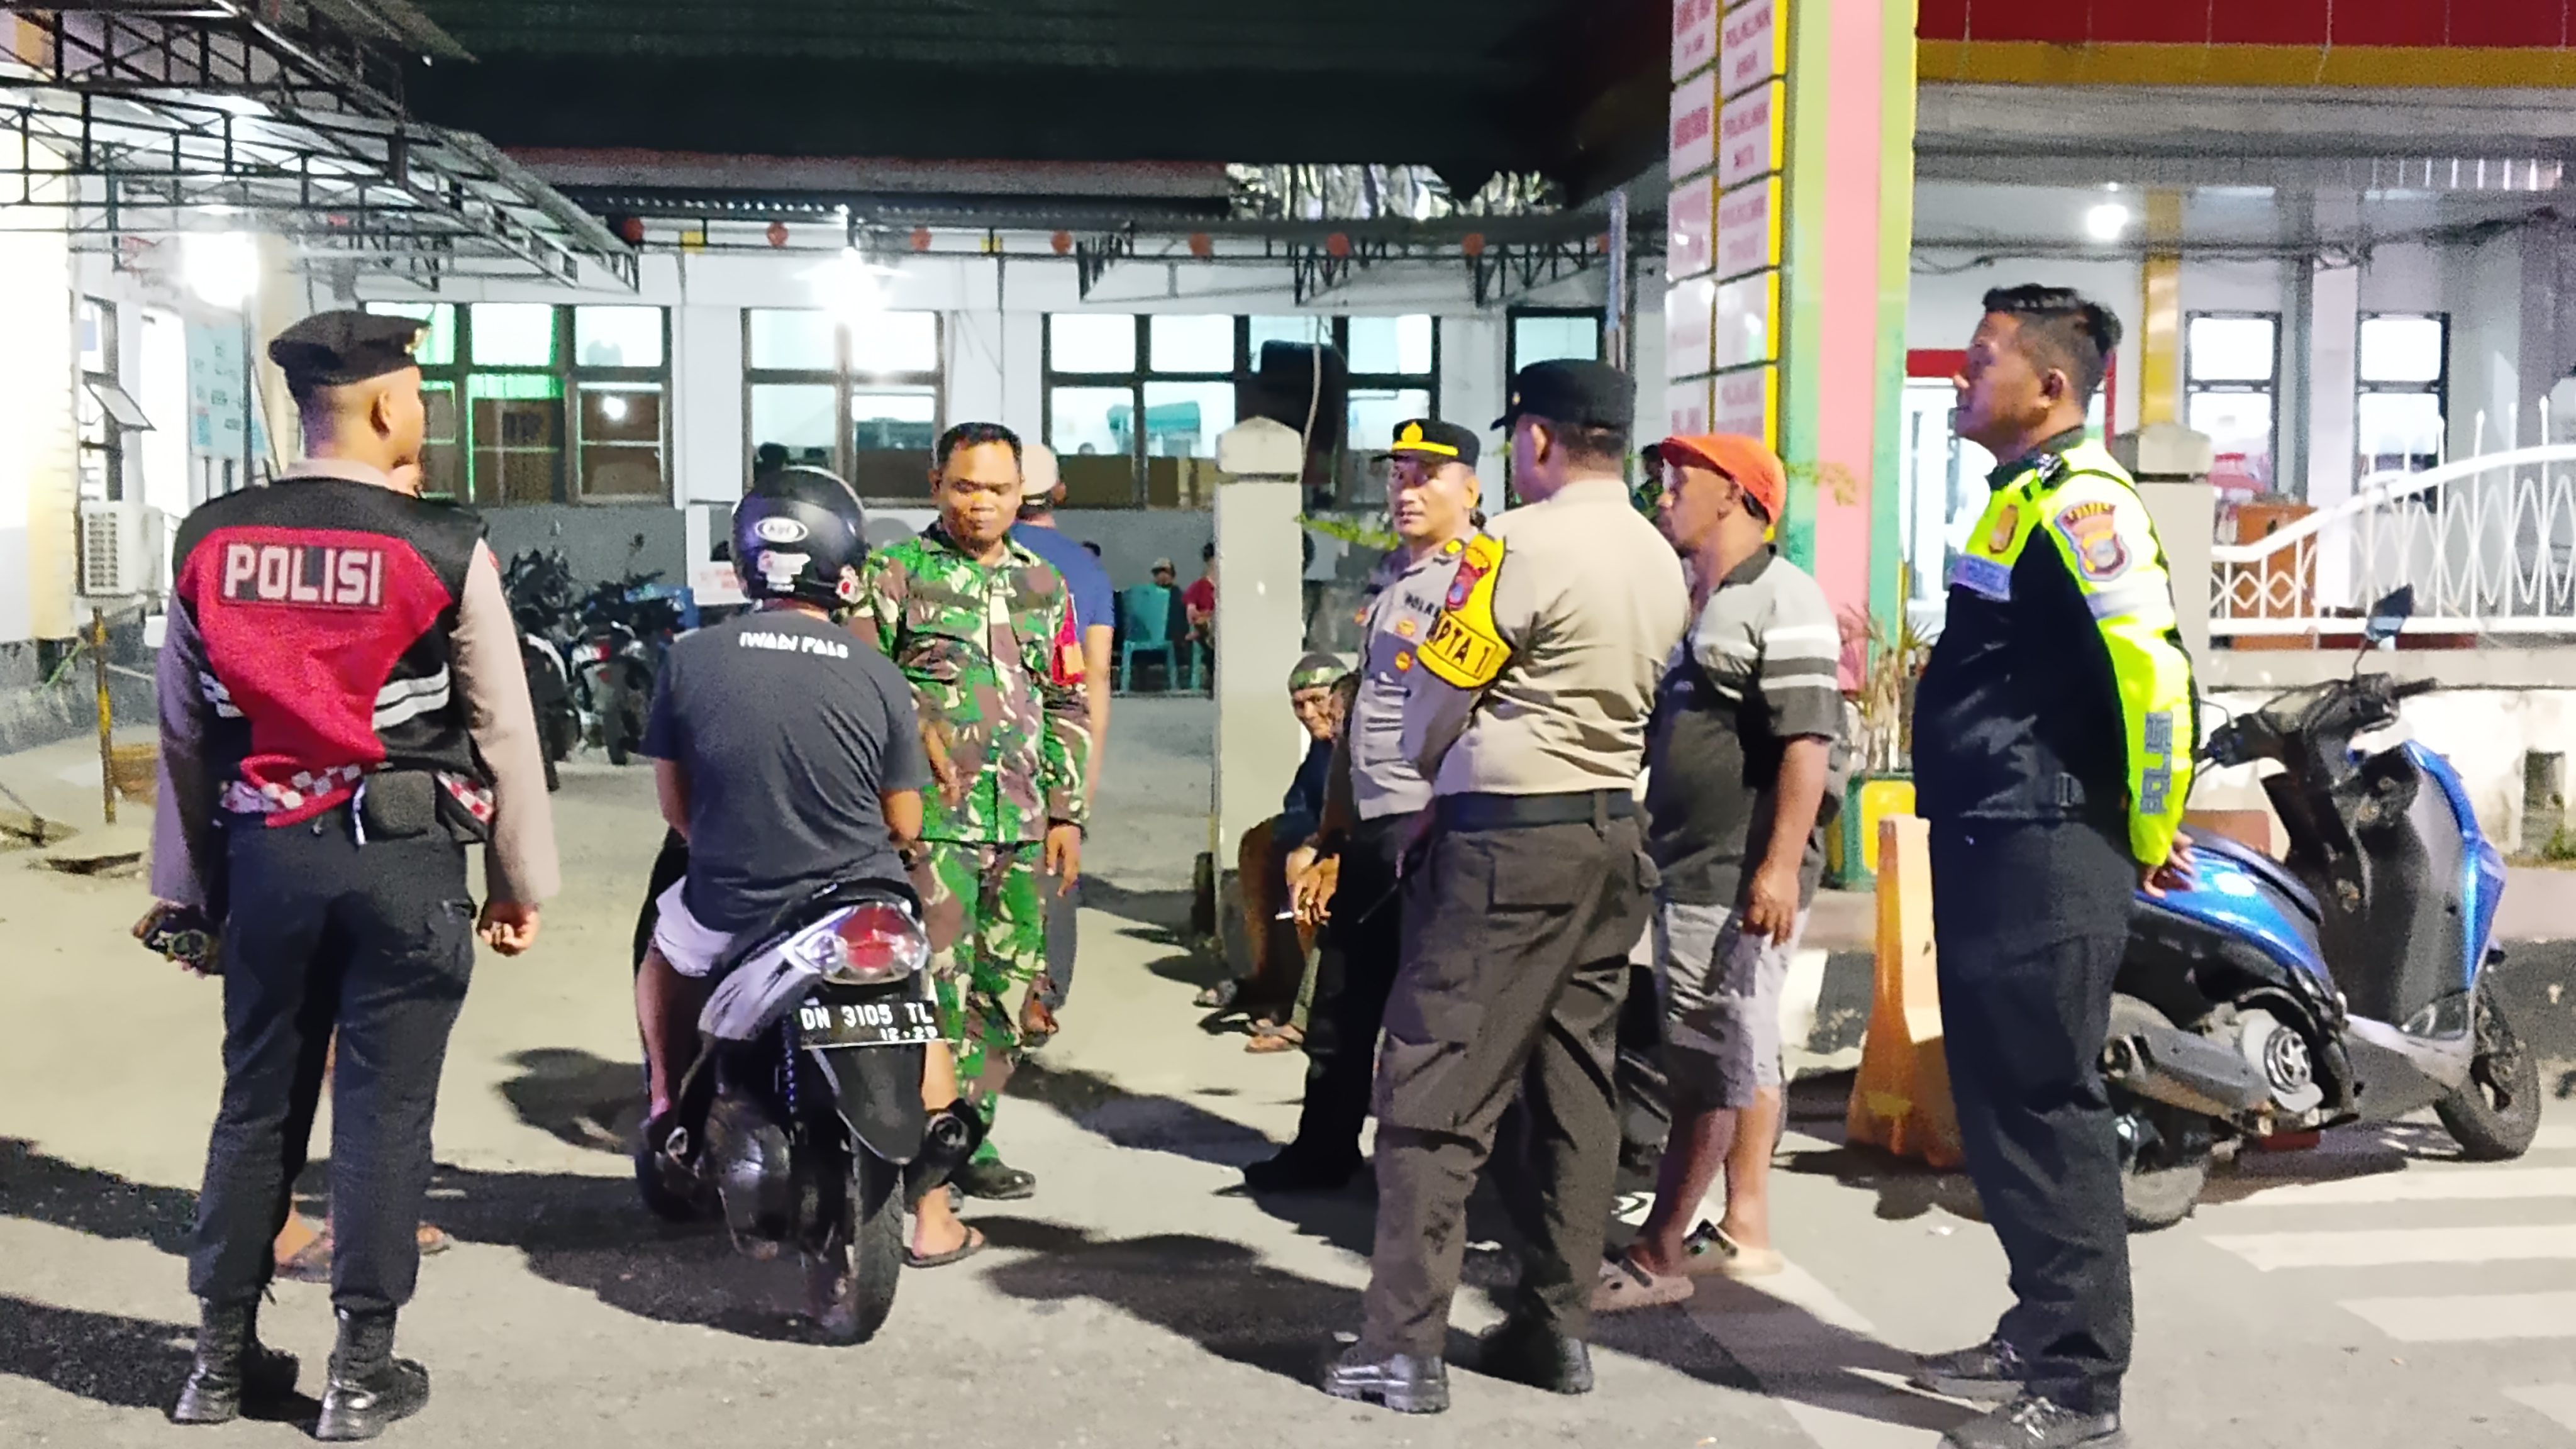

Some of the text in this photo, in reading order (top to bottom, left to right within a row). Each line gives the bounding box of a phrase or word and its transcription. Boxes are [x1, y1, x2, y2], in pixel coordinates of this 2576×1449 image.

[223, 544, 382, 606] POLISI
[739, 631, 799, 652] IWAN
[800, 1002, 935, 1030] DN 3105 TL
